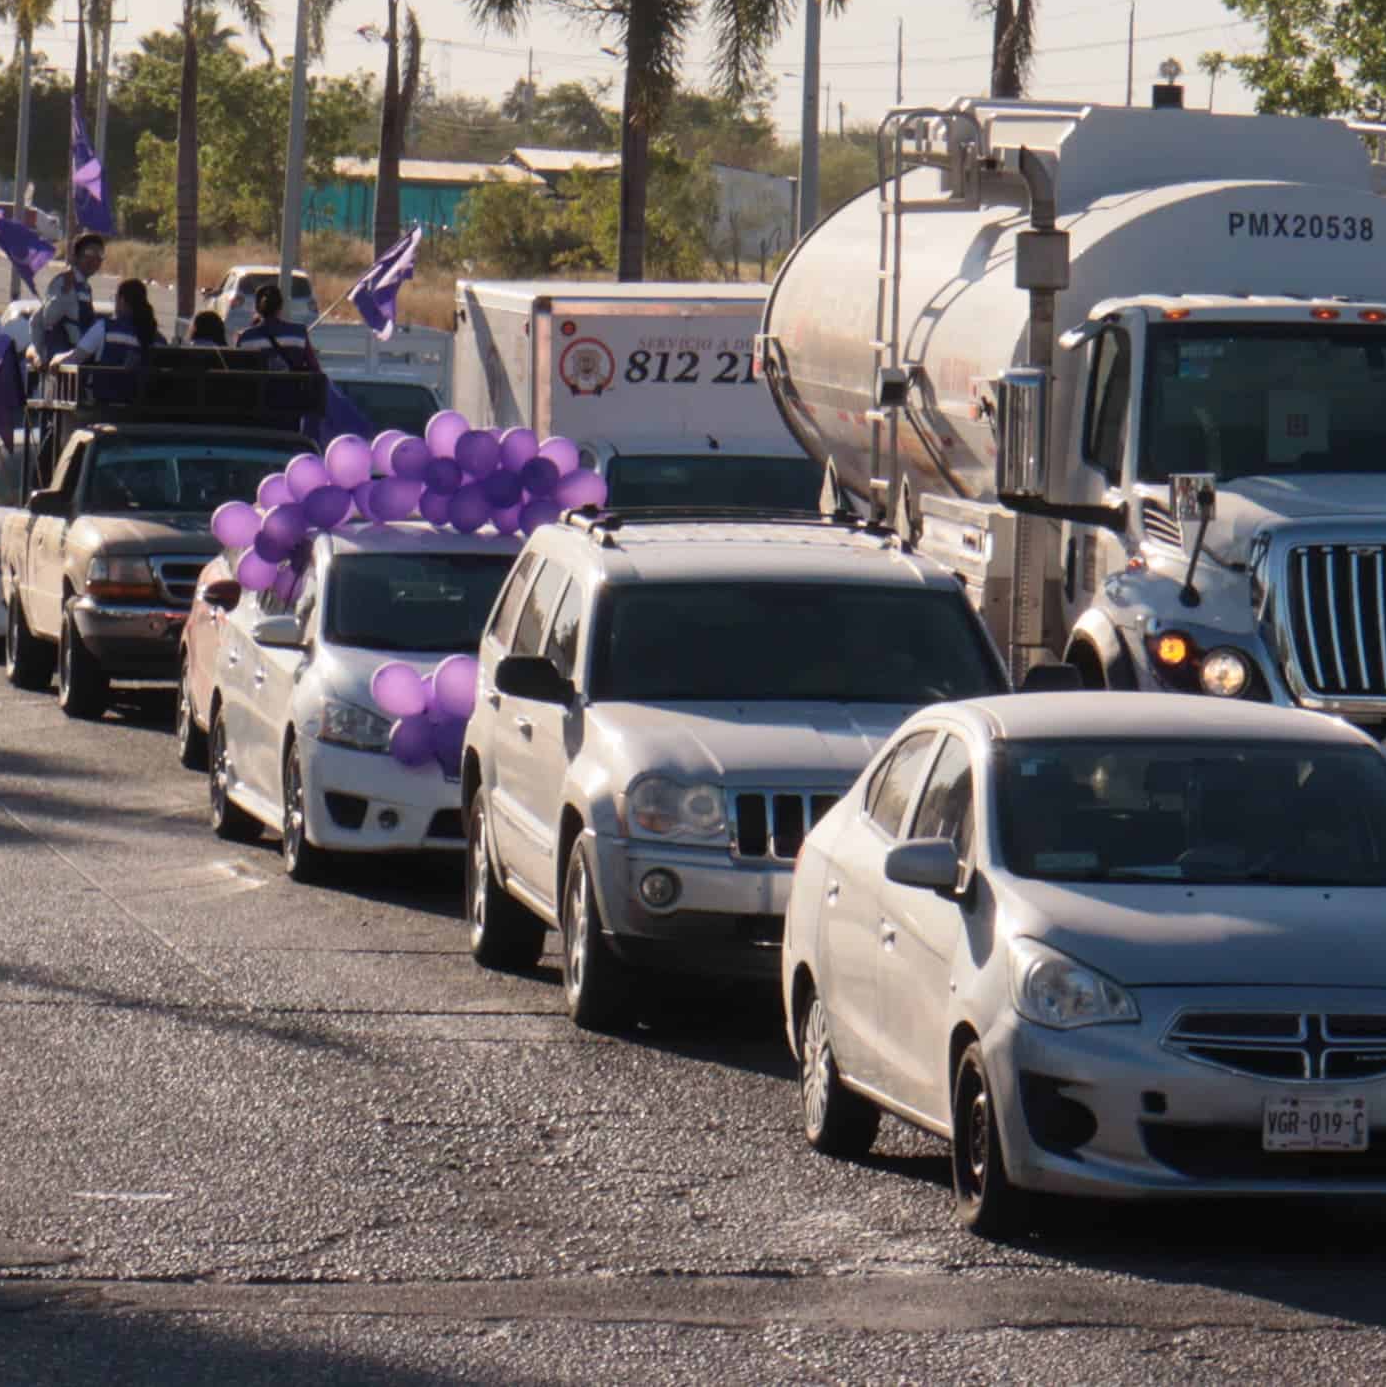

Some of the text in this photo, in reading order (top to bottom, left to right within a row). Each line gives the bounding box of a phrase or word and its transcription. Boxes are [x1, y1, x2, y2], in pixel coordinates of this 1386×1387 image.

[1228, 212, 1374, 241] PMX20538
[624, 350, 700, 384] 812
[1268, 1110, 1365, 1136] VGR-019-C
